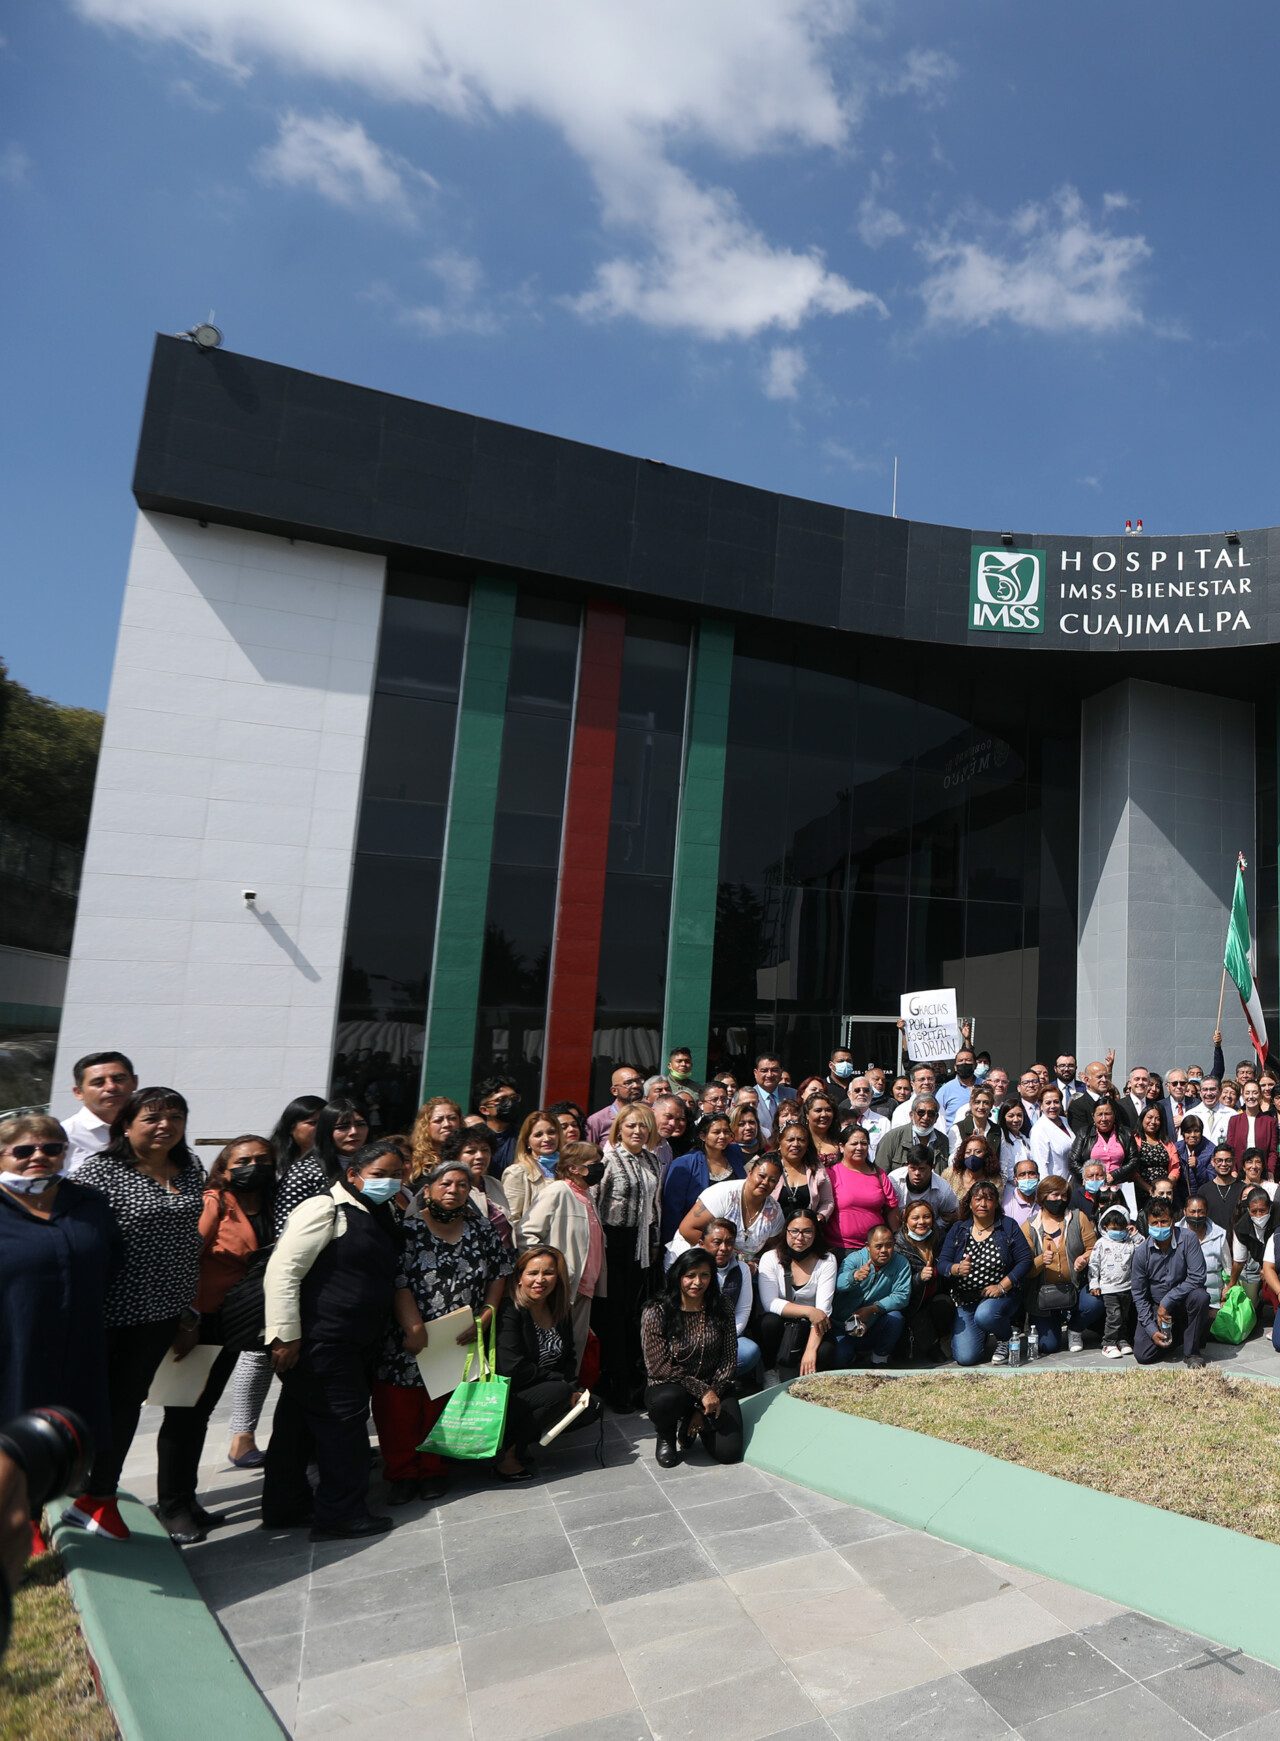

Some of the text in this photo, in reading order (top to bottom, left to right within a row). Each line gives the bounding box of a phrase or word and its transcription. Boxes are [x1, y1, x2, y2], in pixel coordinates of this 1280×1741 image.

[1061, 547, 1251, 572] HOSPITAL
[1060, 577, 1252, 600] IMSS-BIENESTAR
[973, 603, 1040, 629] IMSS
[1059, 609, 1252, 638] CUAJIMALPA
[907, 1028, 951, 1042] HOSPITAL
[908, 1017, 944, 1030] POR EL
